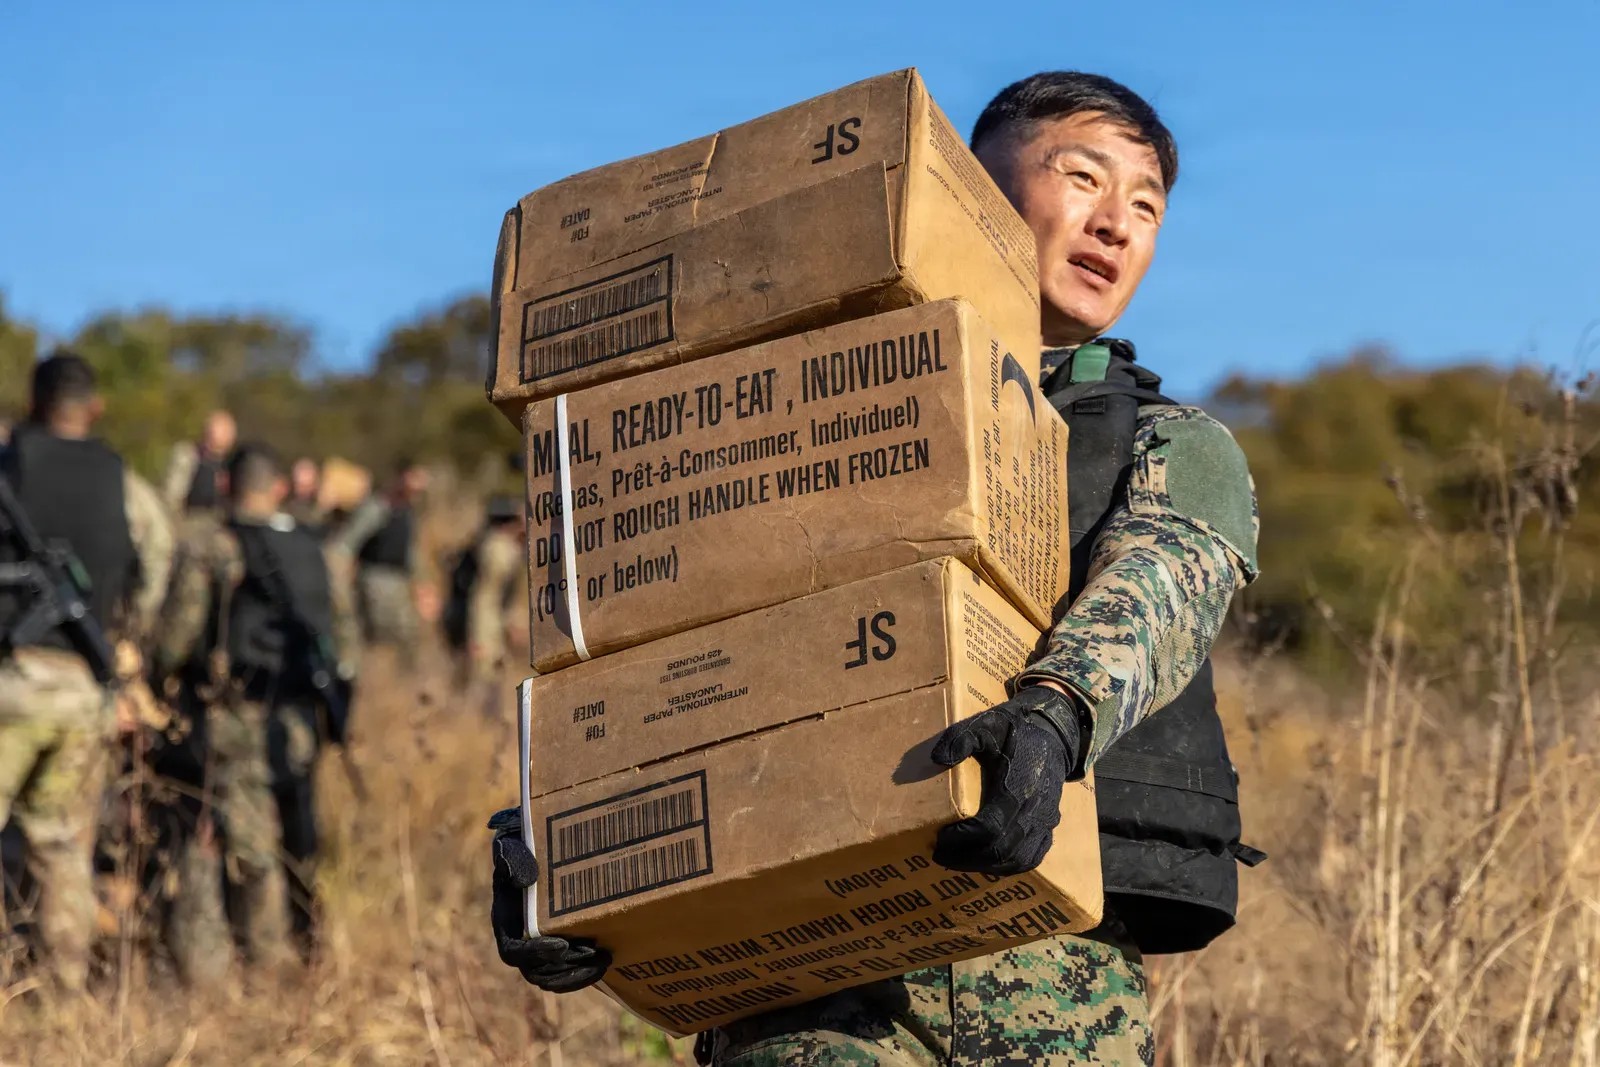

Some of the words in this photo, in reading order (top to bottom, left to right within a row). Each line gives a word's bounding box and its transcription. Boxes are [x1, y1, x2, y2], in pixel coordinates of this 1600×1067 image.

[812, 117, 861, 165] SF
[647, 187, 701, 208] LANCASTER
[560, 208, 591, 229] DATE#
[624, 207, 653, 223] PAPER
[990, 339, 999, 412] INDIVIDUAL
[533, 418, 601, 478] MAL,
[802, 328, 948, 403] INDIVIDUAL
[535, 483, 604, 526] (Reas,
[612, 429, 803, 498] Prêt-à-Consommer,
[811, 395, 920, 447] Individuel)
[536, 532, 561, 568] DO
[573, 517, 606, 555] NOT
[614, 495, 680, 543] ROUGH
[688, 473, 770, 521] HANDLE
[776, 458, 840, 499] WHEN
[849, 438, 930, 485] FROZEN
[1038, 515, 1044, 532] IN
[1028, 531, 1036, 598] MERIQUAL
[1043, 512, 1052, 603] GOVERNMENT
[587, 573, 607, 601] or
[614, 545, 678, 593] below)
[964, 591, 1002, 629] REFRIGERATION
[964, 614, 975, 628] THE
[965, 604, 976, 617] AND
[976, 610, 1002, 639] ISSUANCE
[845, 611, 896, 670] SF
[965, 627, 973, 638] OF
[973, 633, 987, 649] DATE
[976, 625, 984, 636] BE
[985, 633, 997, 646] NOT
[667, 654, 706, 671] POUNDS
[707, 649, 723, 660] 425
[967, 640, 988, 661] SHOULD
[660, 675, 671, 684] TEST
[967, 651, 1002, 684] CONTROLLED
[668, 683, 723, 706] LANCASTER
[675, 686, 748, 714] INTERNATIONAL
[573, 700, 605, 723] DATE#
[643, 708, 673, 724] PAPER
[585, 723, 606, 742] FO#
[904, 855, 930, 873] or
[824, 863, 906, 898] below)
[931, 872, 980, 901] NOT
[850, 889, 932, 926] ROUGH
[951, 880, 1037, 917] (Repas,
[761, 913, 854, 951] HANDLE
[977, 900, 1072, 939] MEAL,
[697, 938, 770, 966] WHEN
[754, 913, 956, 974] Prêt-à-Consommer,
[615, 953, 703, 982] FROZEN
[647, 967, 760, 998] Individuel)
[648, 981, 802, 1026] INDIVIDUAL
